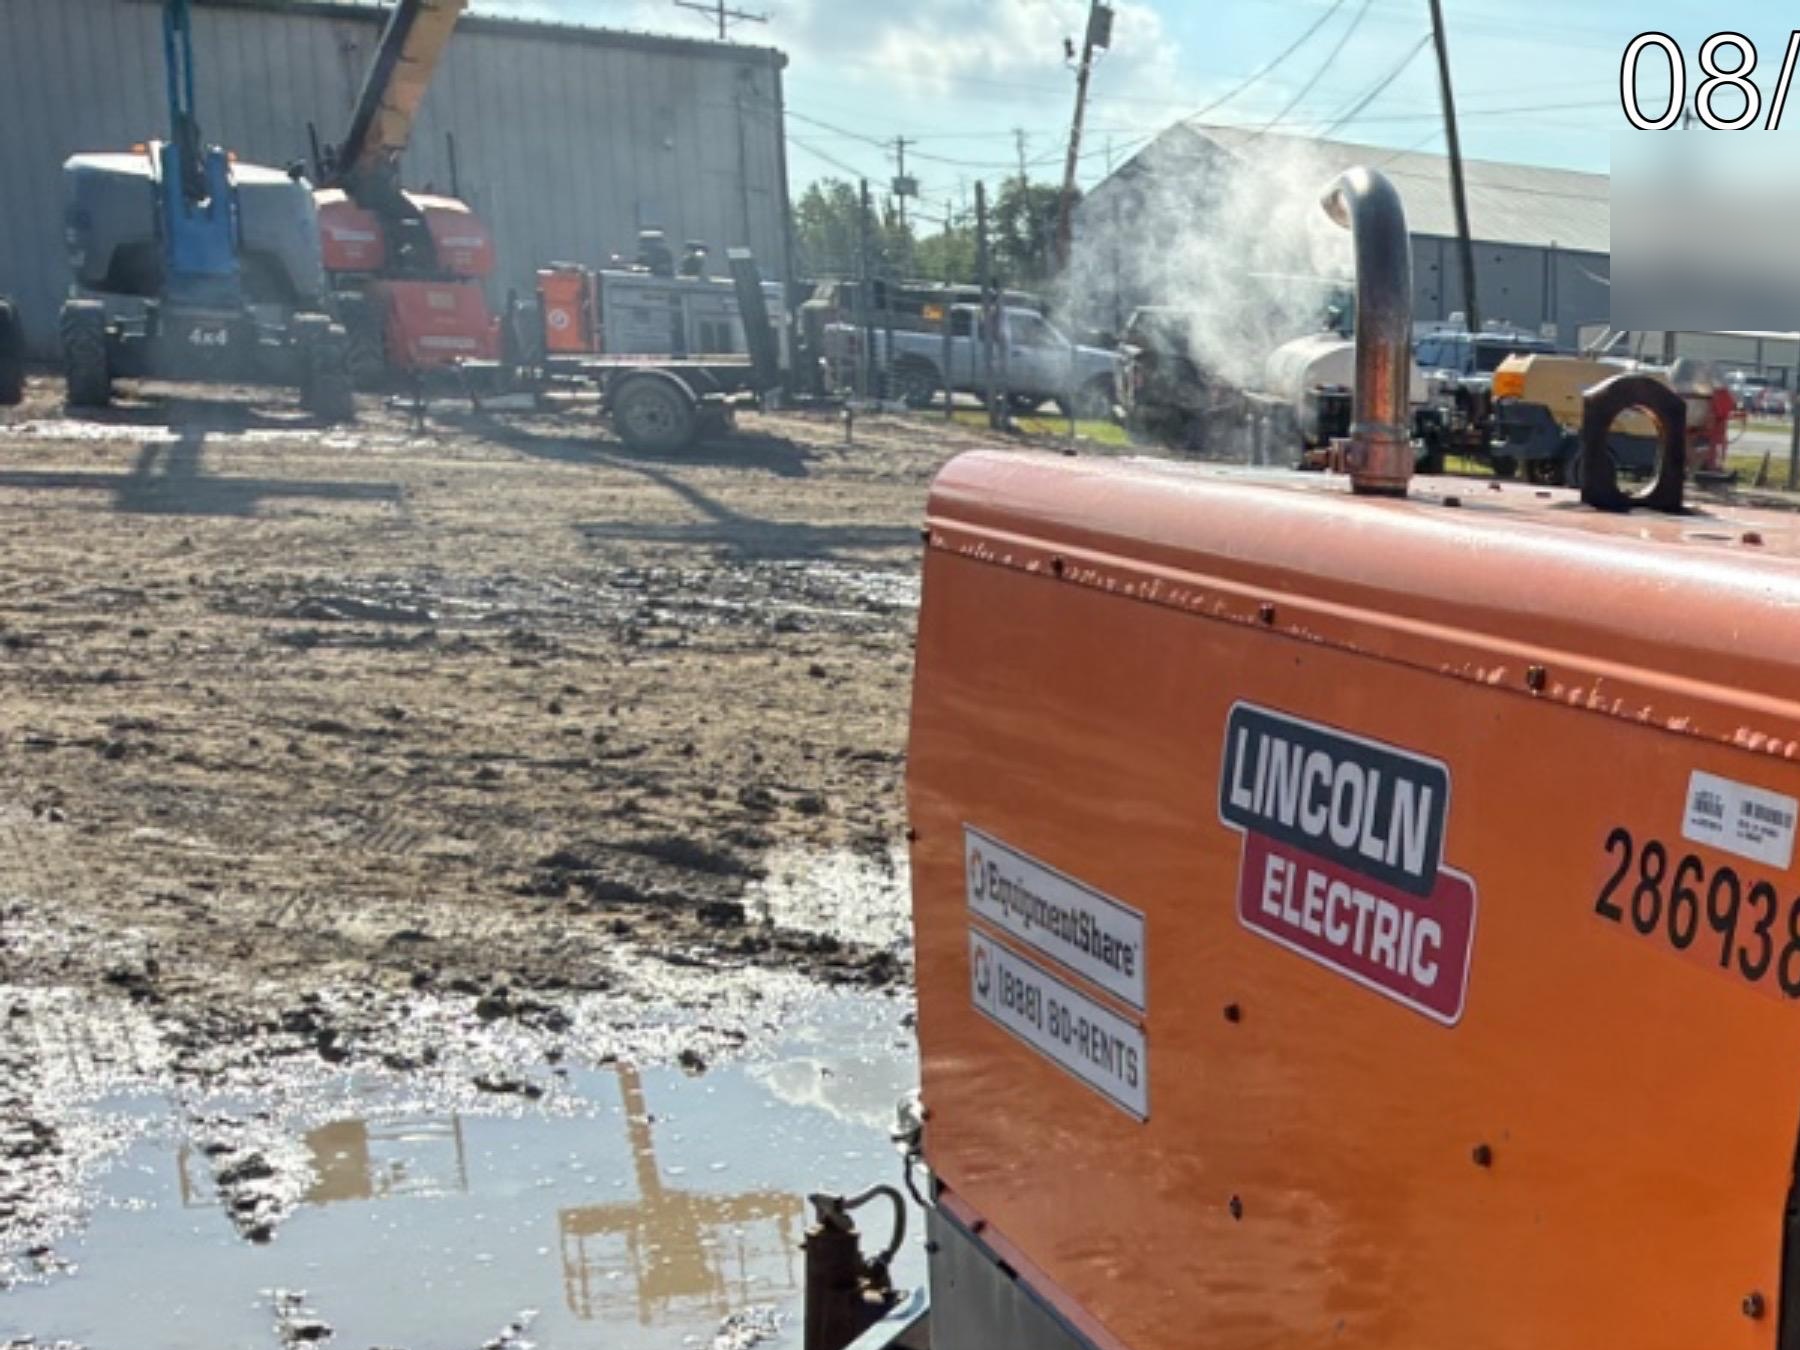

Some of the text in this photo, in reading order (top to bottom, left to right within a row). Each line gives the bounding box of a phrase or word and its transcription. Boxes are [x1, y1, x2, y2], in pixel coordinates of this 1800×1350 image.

[1230, 727, 1433, 876] LINCOLN
[987, 859, 1137, 979] EquipmentShare
[1261, 853, 1442, 987] ELECTRIC
[1049, 995, 1139, 1091] 80-RENTS
